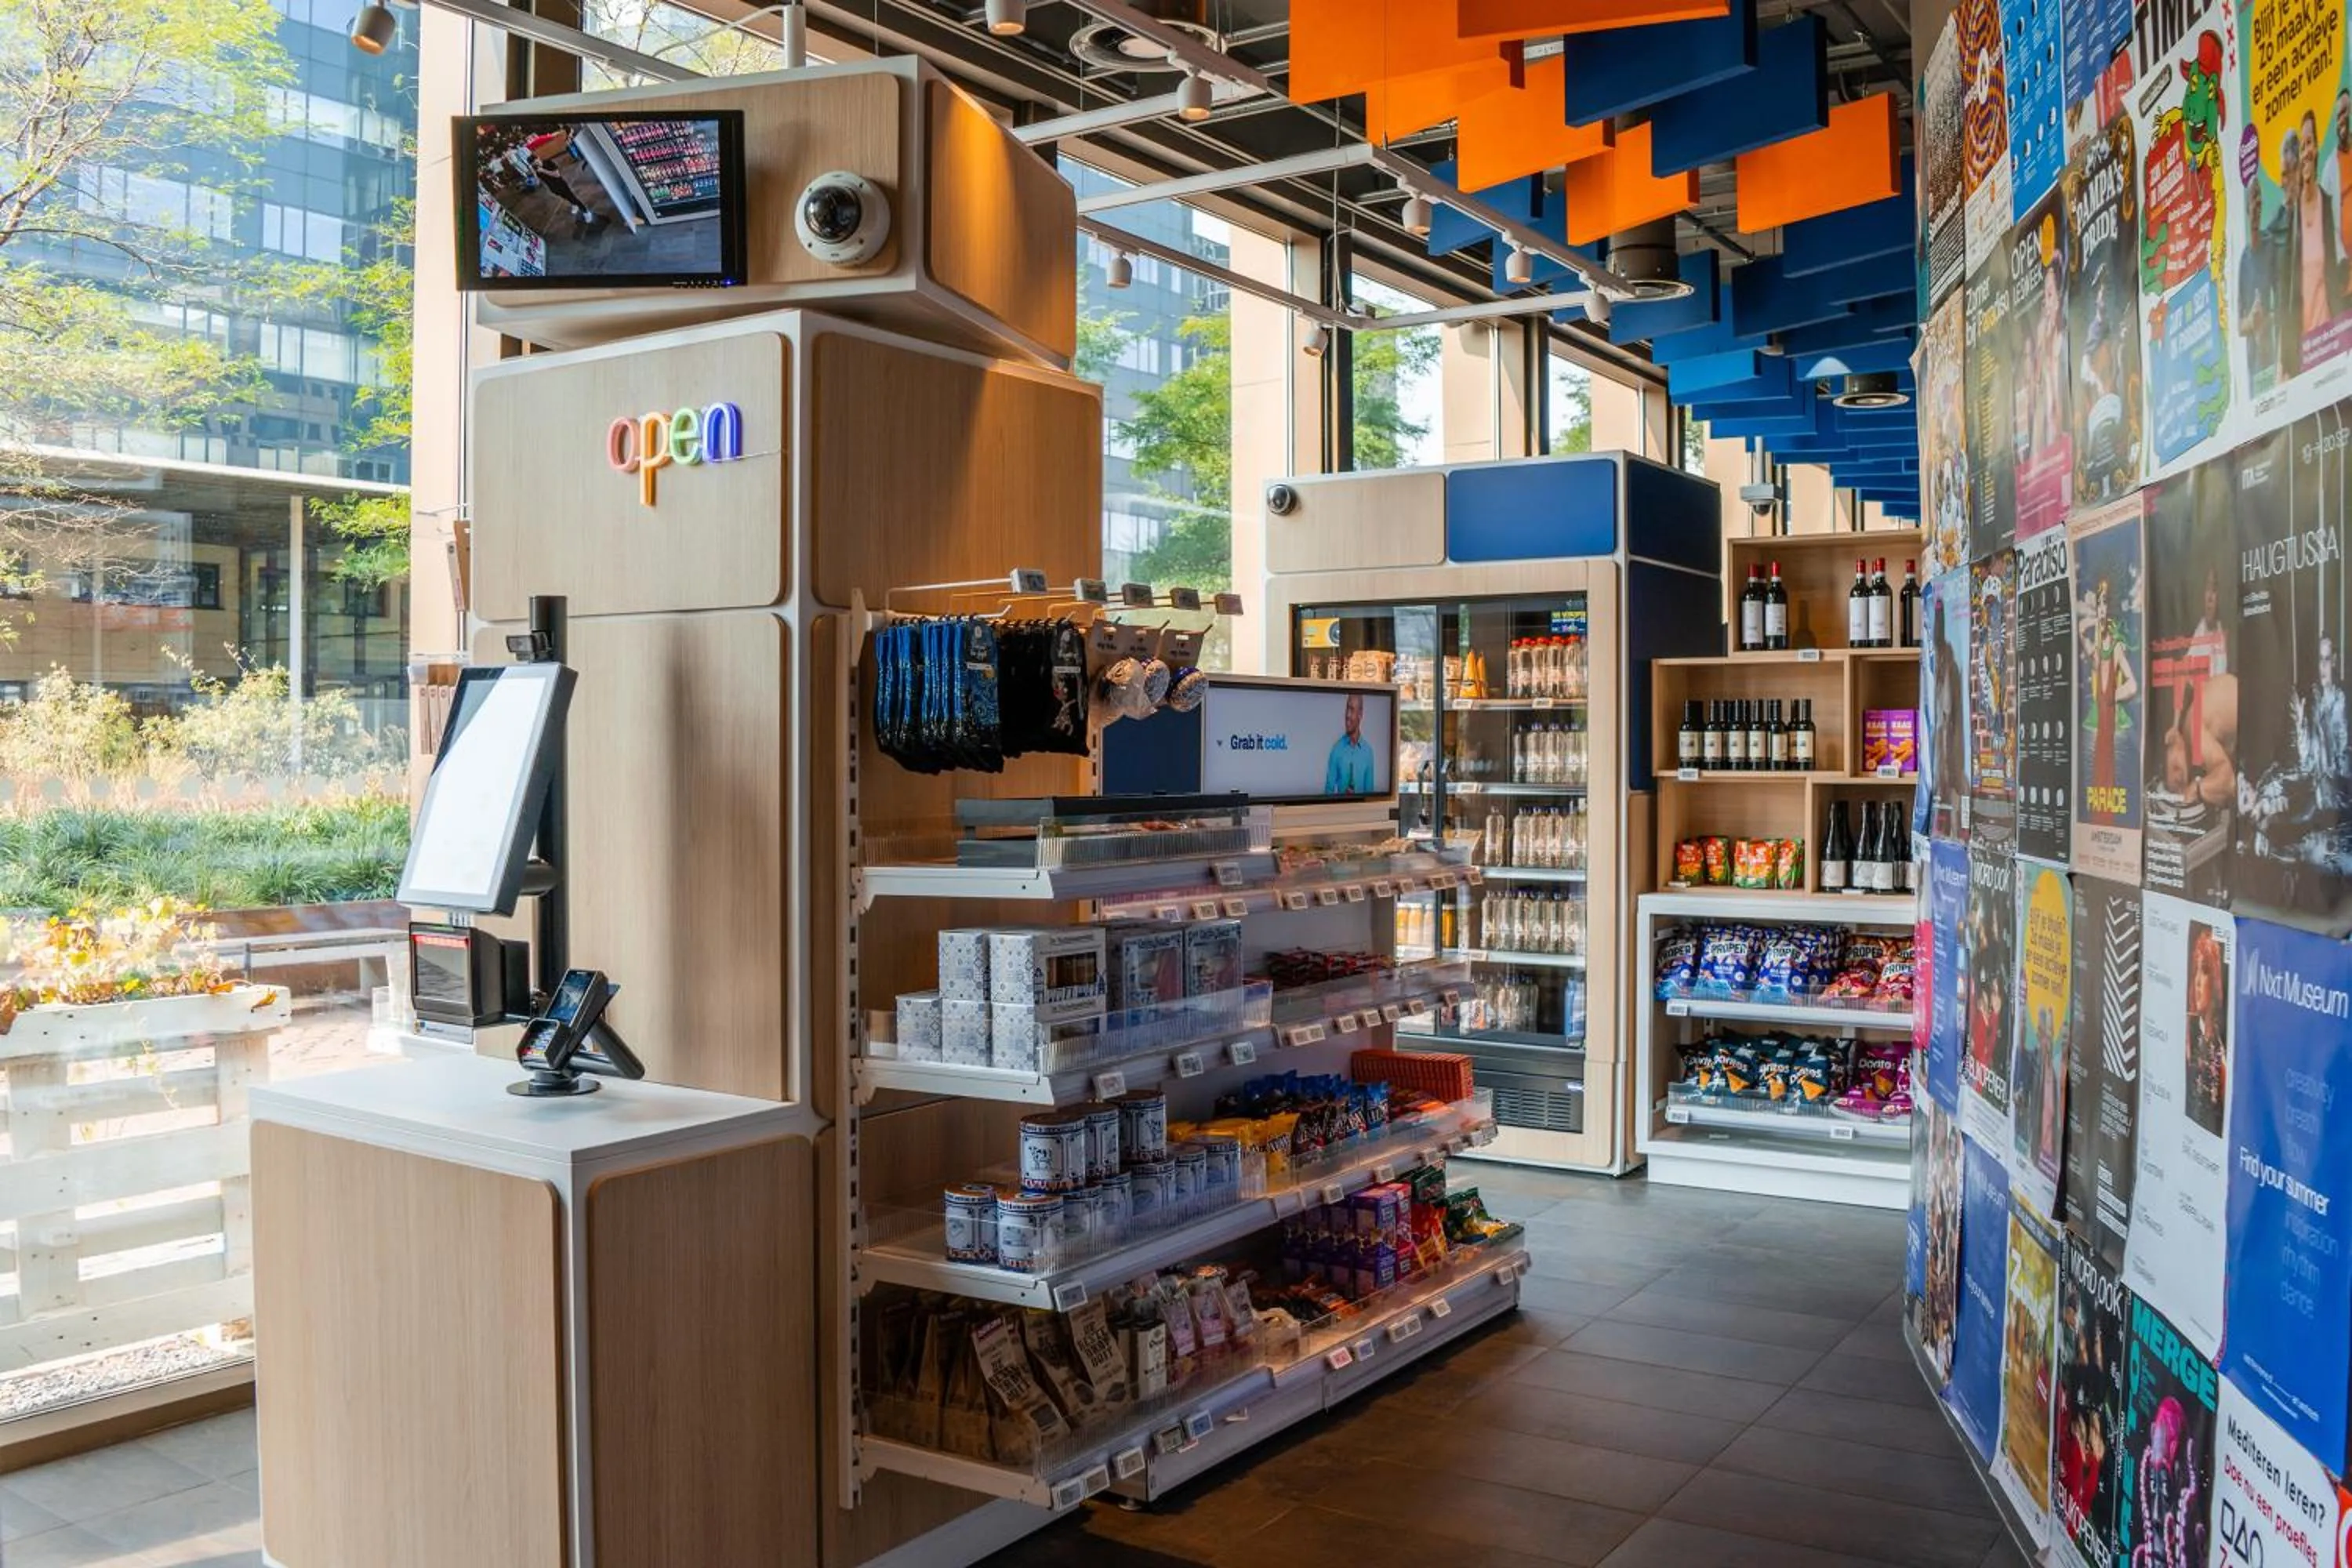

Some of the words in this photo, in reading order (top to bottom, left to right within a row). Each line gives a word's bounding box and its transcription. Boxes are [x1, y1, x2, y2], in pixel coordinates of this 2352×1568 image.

[2252, 78, 2265, 105] er
[2267, 56, 2288, 92] een
[2291, 9, 2338, 69] actieve
[2254, 0, 2275, 44] Blijf
[2259, 42, 2274, 71] Zo
[2276, 0, 2314, 52] maak
[2265, 73, 2303, 124] zomer
[2305, 34, 2333, 85] van!
[2011, 226, 2042, 280] OPEN
[2082, 202, 2119, 272] PRIDE
[607, 401, 743, 508] open
[2016, 535, 2068, 594] Paradiso
[1230, 734, 1254, 750] Grab
[1256, 733, 1264, 750] it
[1265, 733, 1288, 750] cold.
[2086, 786, 2127, 814] PARADE
[2283, 970, 2349, 1019] Museum
[2240, 1145, 2260, 1178] Find
[2259, 1161, 2286, 1191] your
[2285, 1174, 2330, 1217] summer
[2071, 1247, 2098, 1295] WORD
[2097, 1276, 2123, 1322] OOK
[2132, 1295, 2217, 1414] MERGE
[2227, 1413, 2281, 1488] Mediteren
[2285, 1468, 2326, 1529] leren?
[2223, 1454, 2243, 1487] Doe
[2244, 1479, 2255, 1501] nu
[2256, 1493, 2273, 1523] een
[2275, 1512, 2318, 1568] proefles
